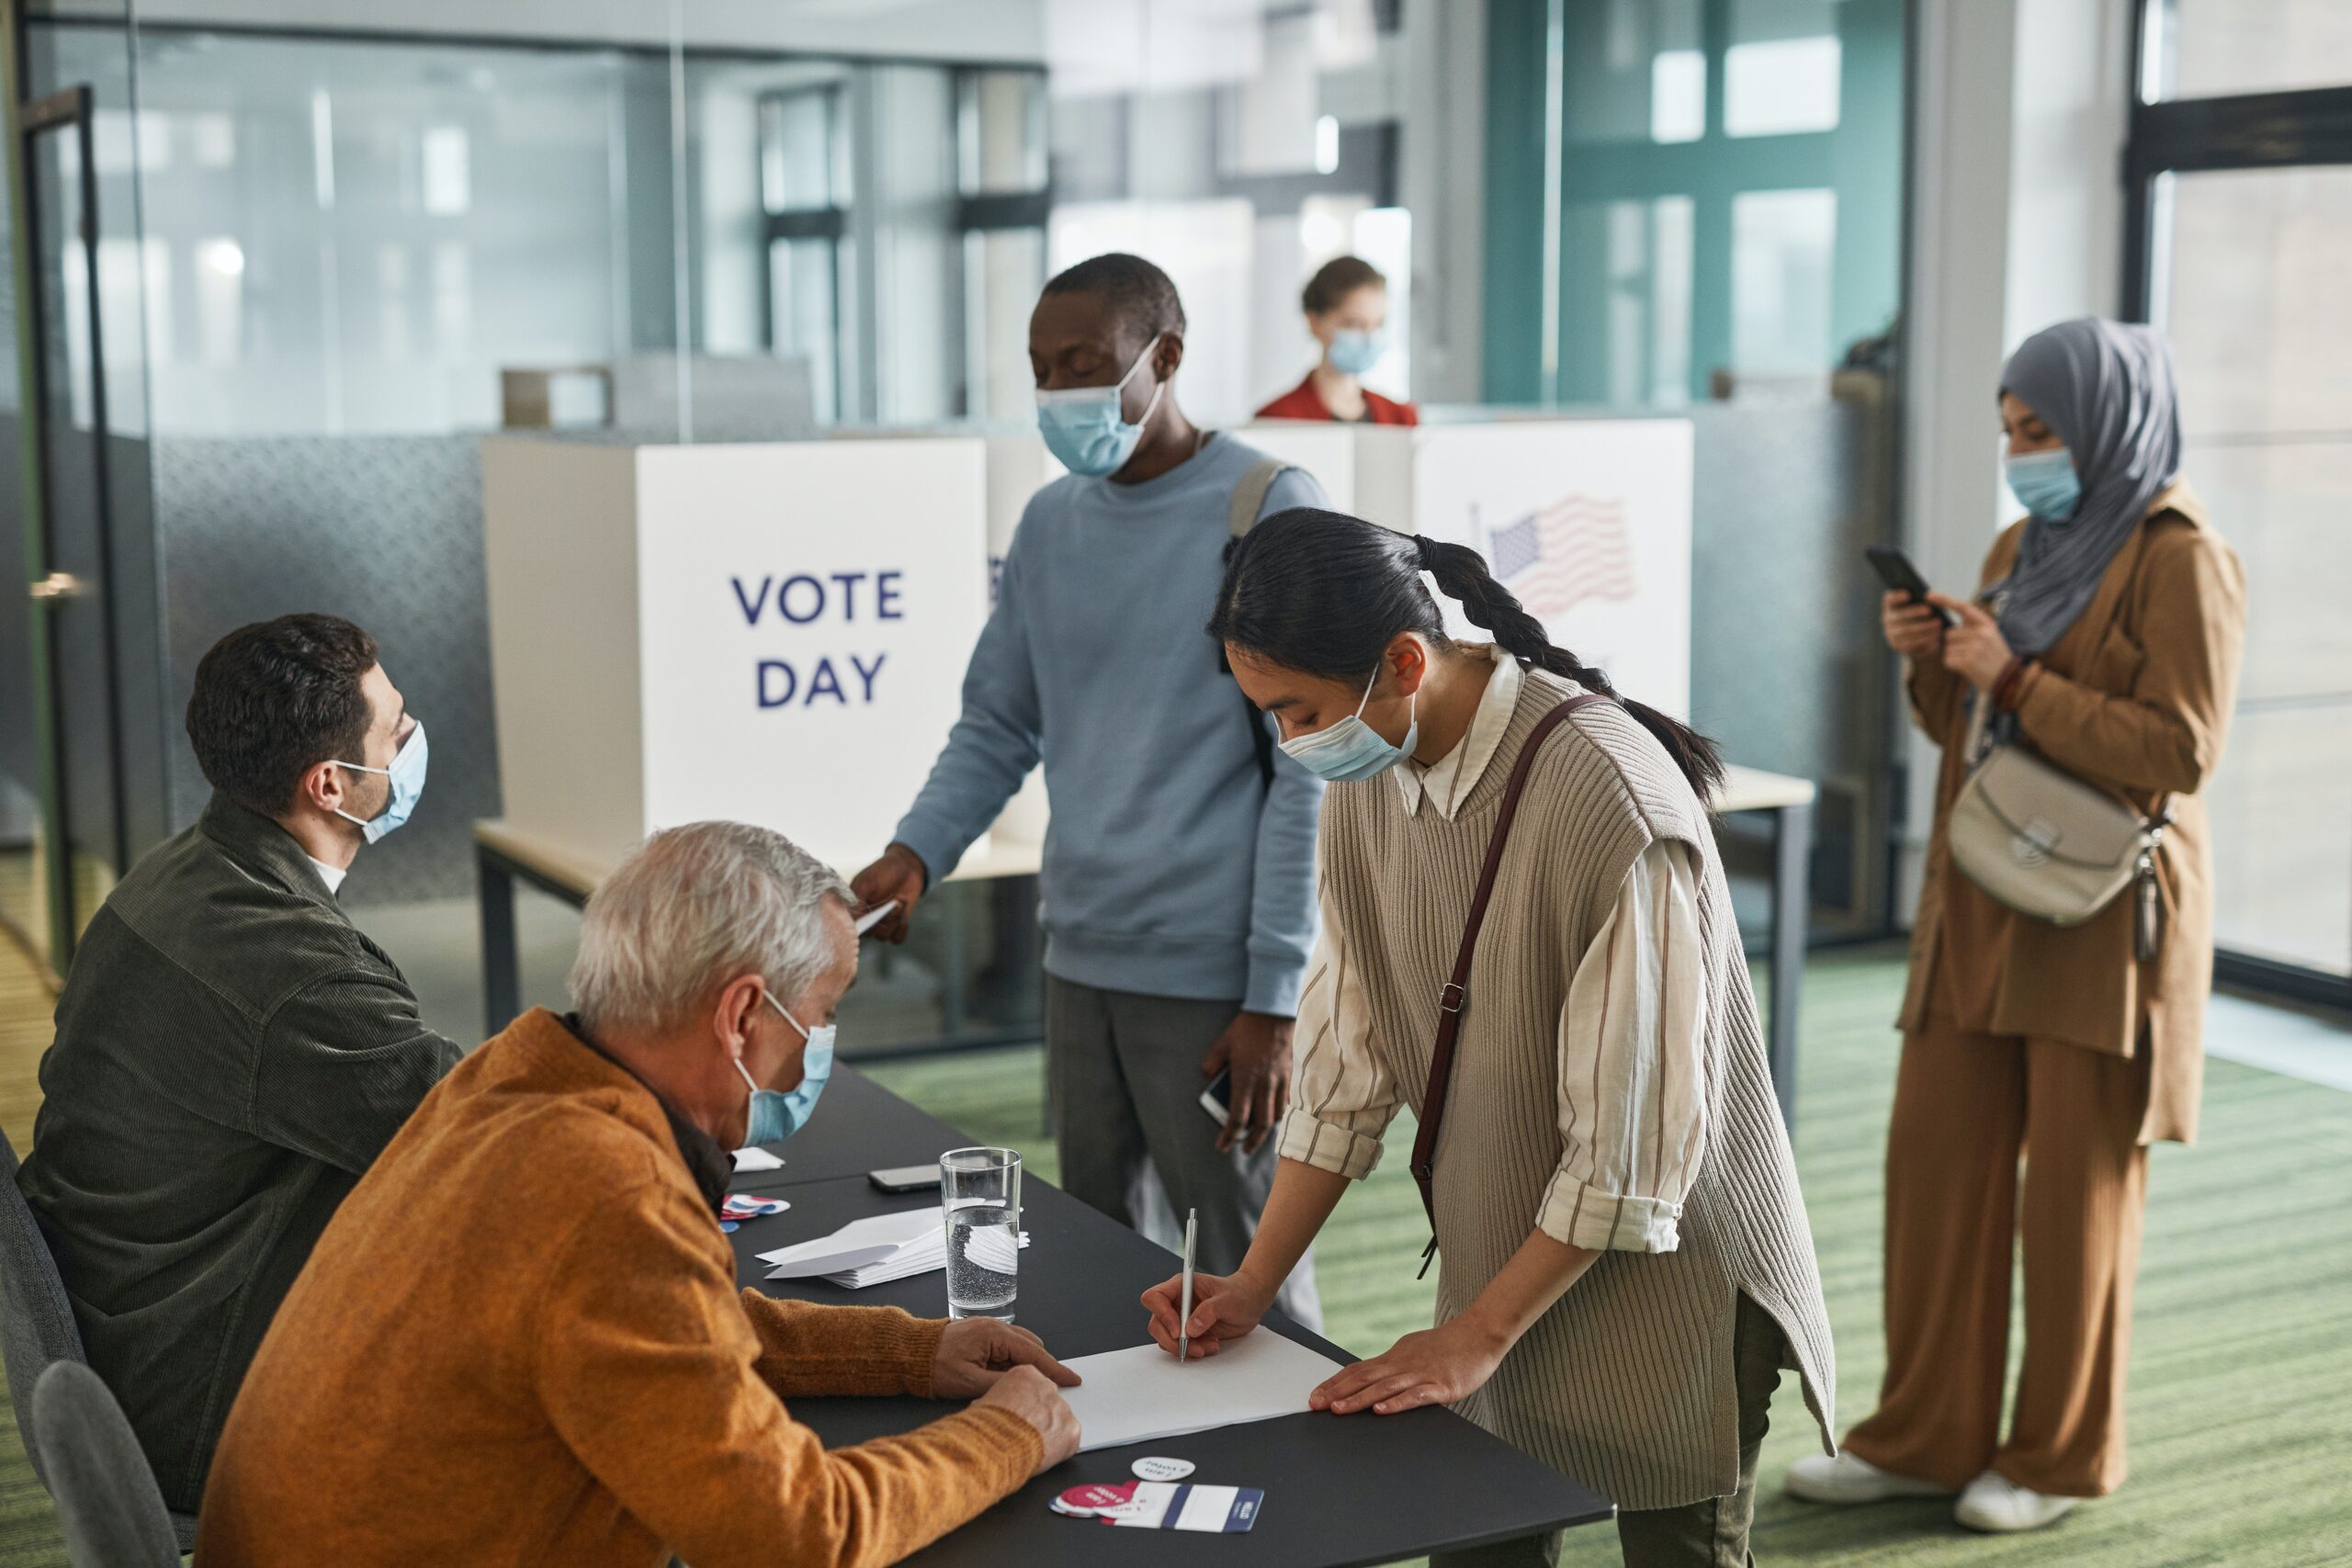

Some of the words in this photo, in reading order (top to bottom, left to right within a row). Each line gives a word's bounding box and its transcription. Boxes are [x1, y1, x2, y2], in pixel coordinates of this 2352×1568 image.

[730, 571, 904, 626] VOTE
[756, 652, 886, 708] DAY
[1239, 1501, 1254, 1519] HELLO
